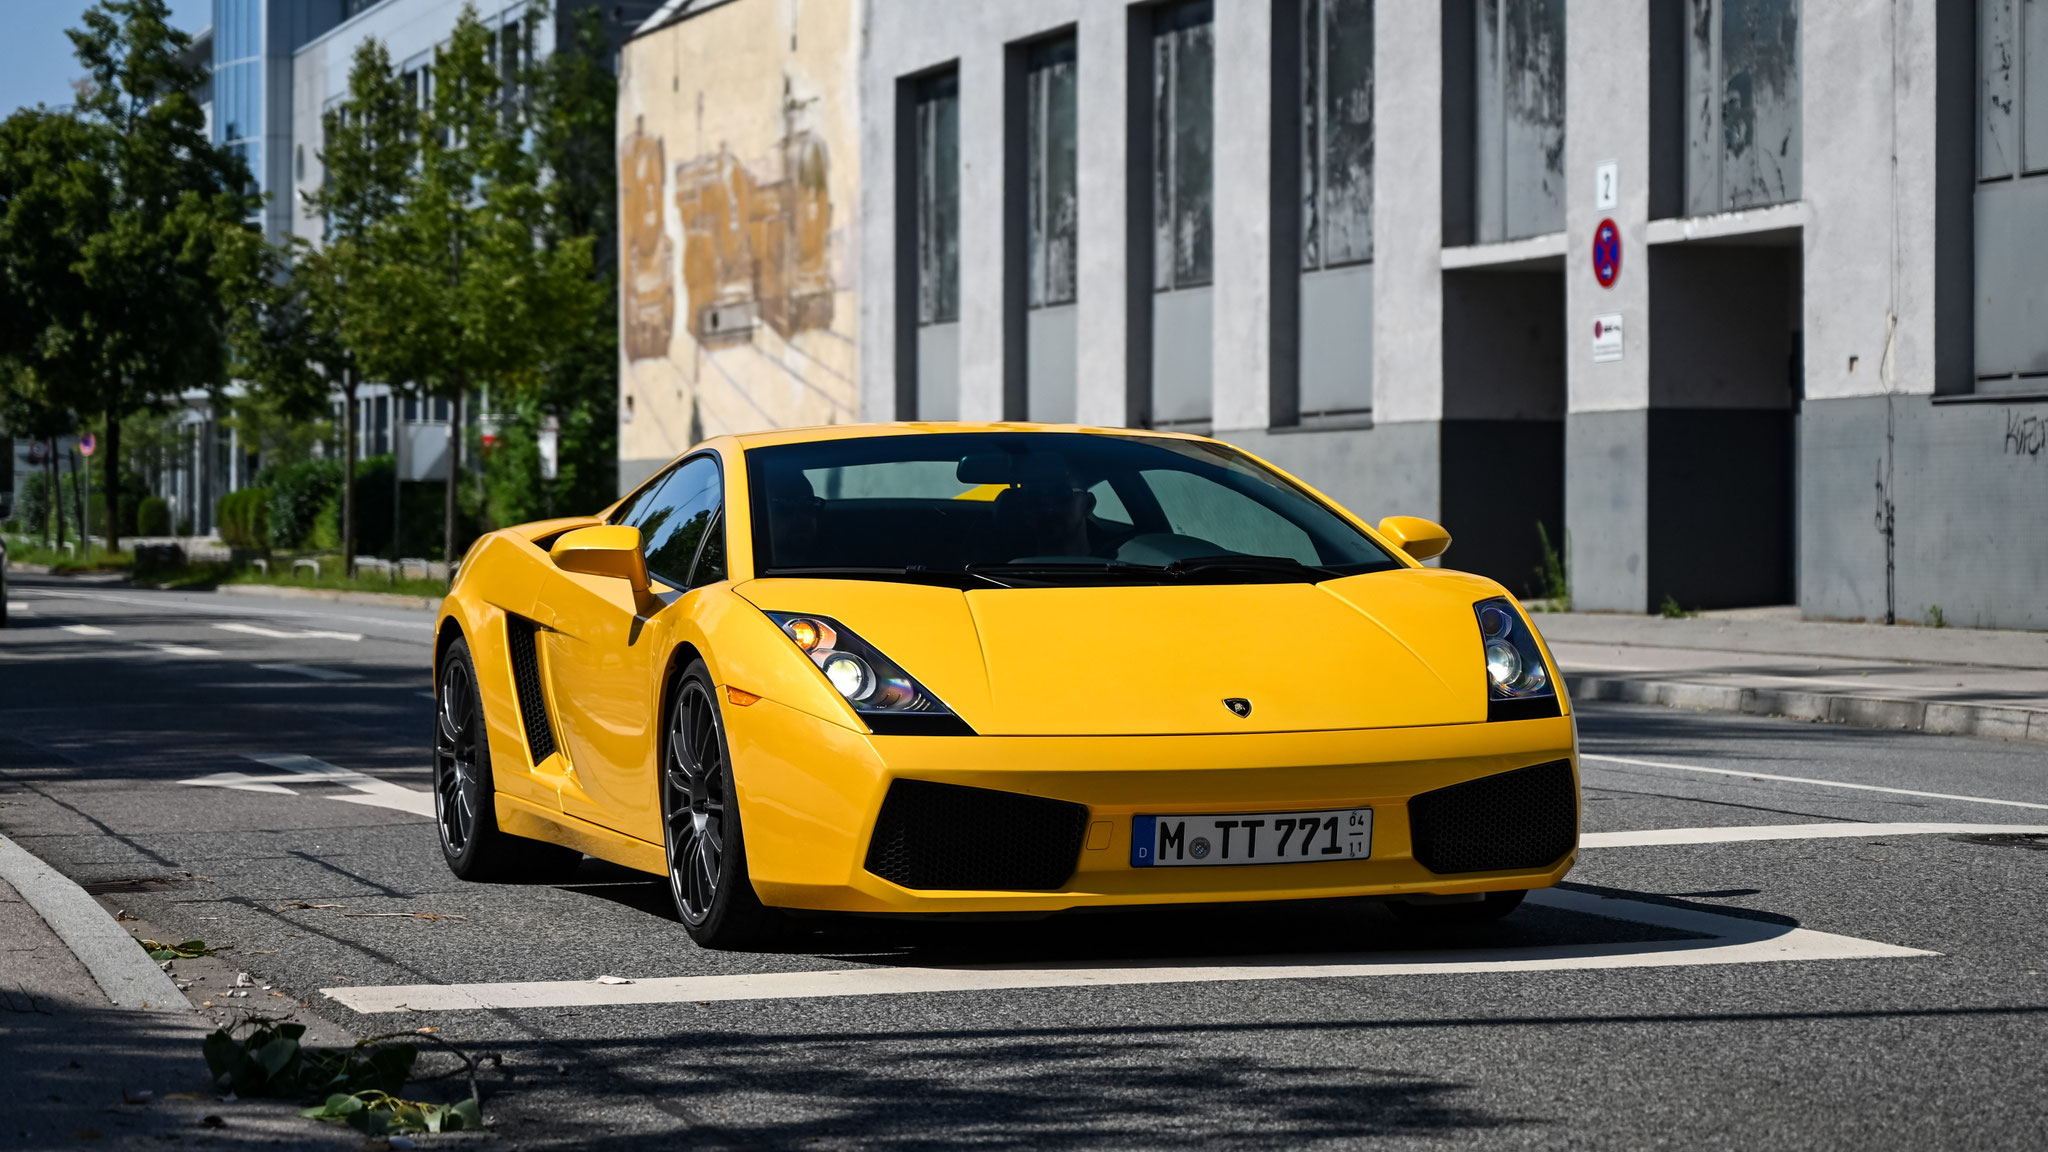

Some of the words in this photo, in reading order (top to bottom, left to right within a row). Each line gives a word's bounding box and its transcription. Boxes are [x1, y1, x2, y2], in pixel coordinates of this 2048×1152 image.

[1349, 815, 1364, 827] 04
[1159, 821, 1186, 860] M
[1214, 820, 1265, 859] TT
[1274, 816, 1343, 857] 771
[1138, 847, 1148, 858] D
[1349, 841, 1362, 853] 11
